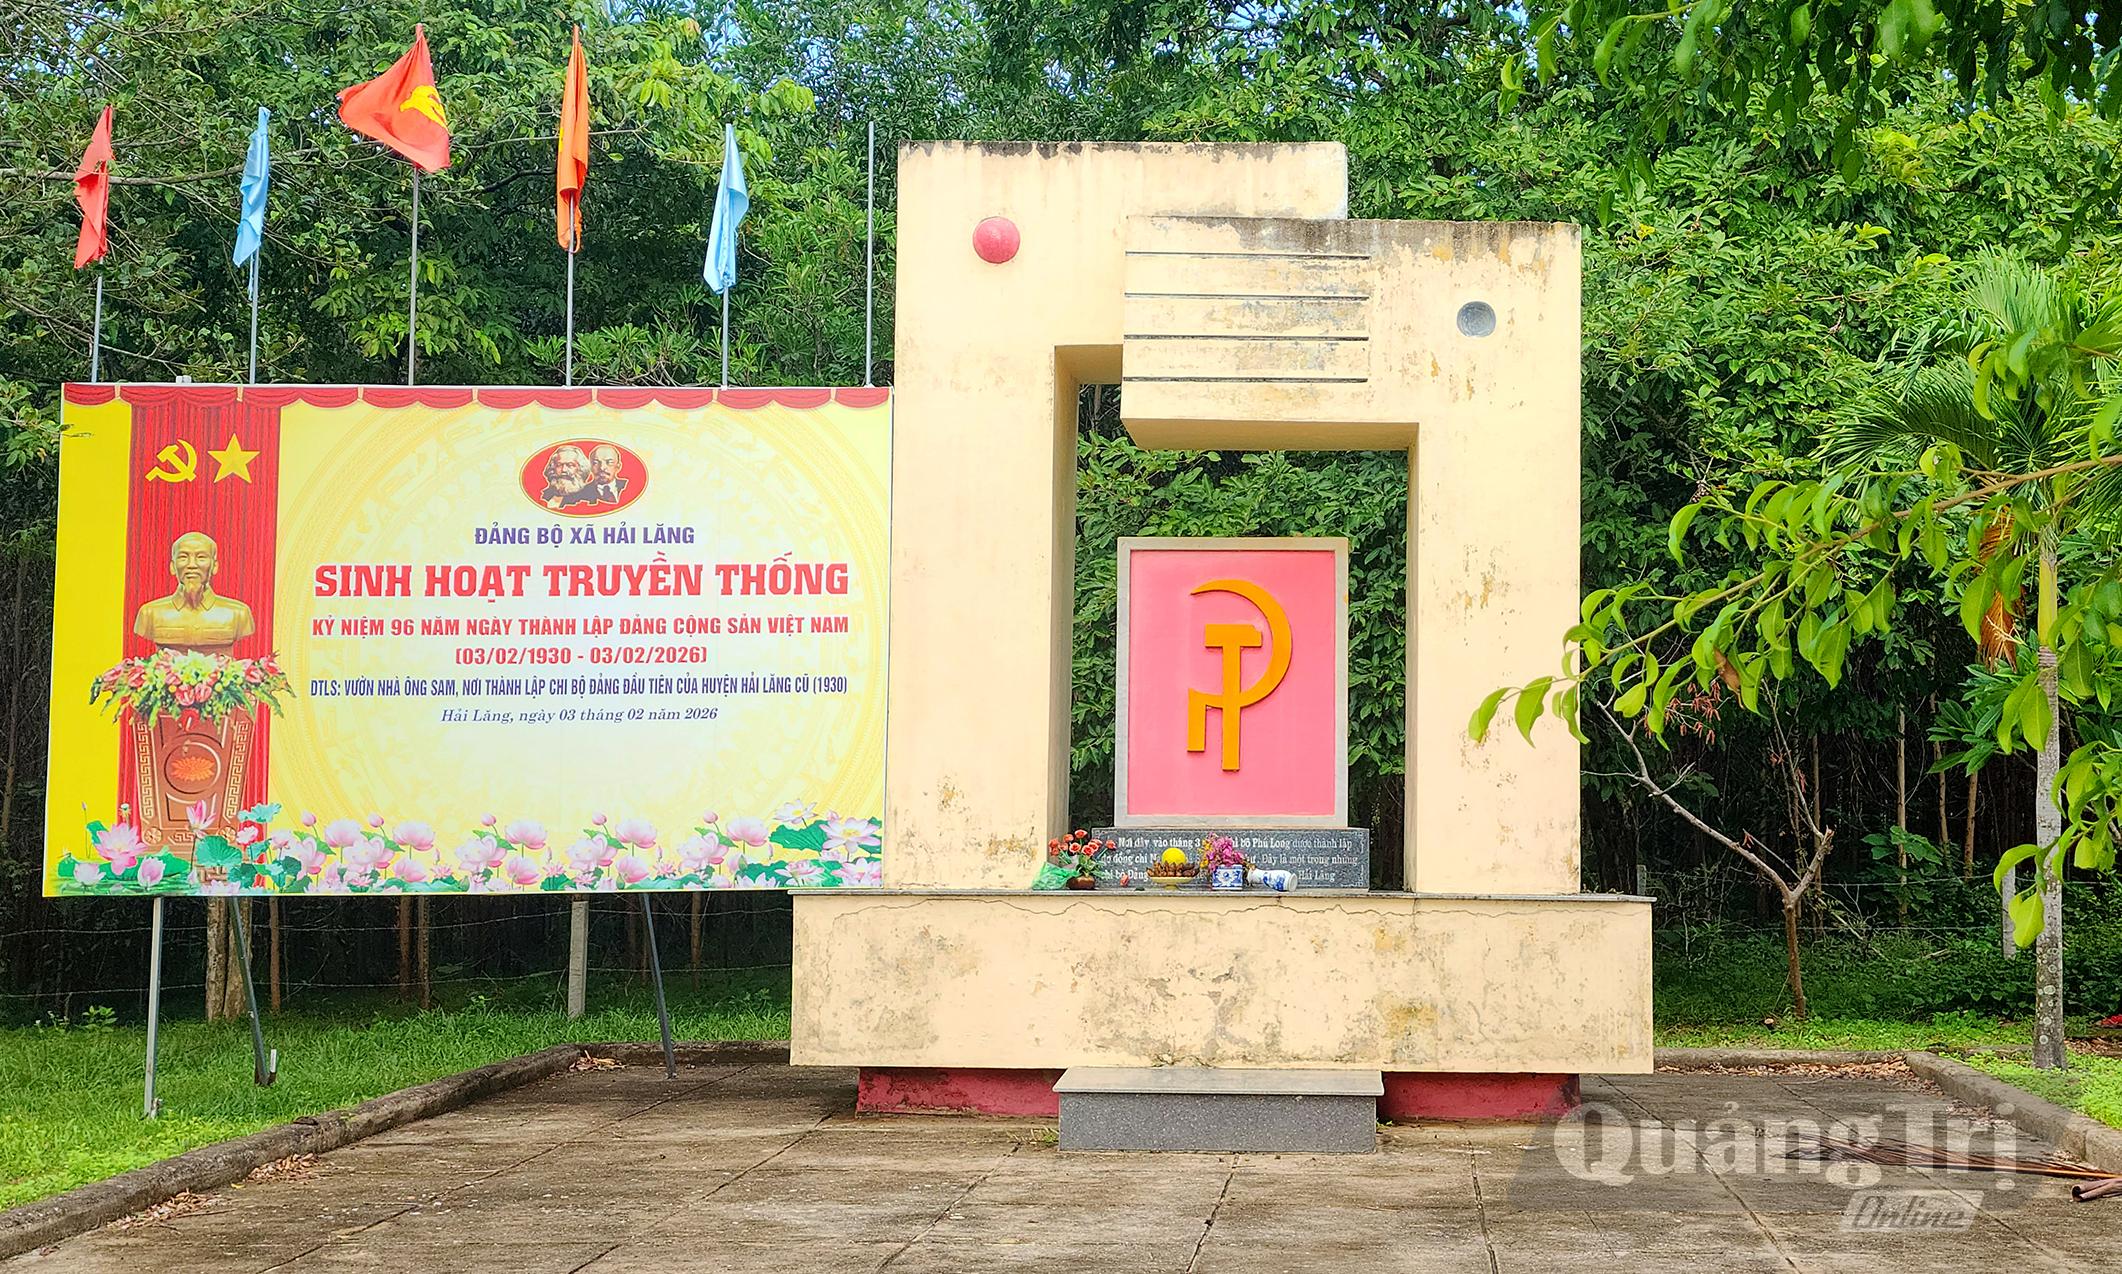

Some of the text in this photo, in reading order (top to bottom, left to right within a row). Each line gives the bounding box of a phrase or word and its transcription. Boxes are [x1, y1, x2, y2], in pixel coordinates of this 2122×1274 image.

[474, 521, 695, 548] ĐẢNG BỘ XÃ HẢI LĂNG
[314, 551, 848, 603] SINH HOẠT TRUYỀN THỐNG
[312, 613, 849, 639] KỶ NIỆM 96 NĂM NGÀY THÀNH LẬP ĐẢNG CỘNG SẢN VIỆT NAM
[455, 647, 571, 665] (03/02/1930
[590, 646, 707, 664] 03/02/2026)
[311, 671, 847, 699] DTLS: VƯỜN NHÀ ÔNG SAM, NƠI THÀNH LẬP CHI BỘ ĐẢNG ĐẦU TIÊN CỦA HUYỆN HẢI LĂNG CŨ (1930)
[442, 707, 719, 724] Hải Lăng, ngày 03 tháng 02 năm 2026
[1153, 837, 1168, 848] vào
[1169, 837, 1193, 849] tháng
[1252, 836, 1269, 848] Phú
[1270, 837, 1291, 850] Long
[1313, 838, 1337, 848] thành
[1279, 853, 1287, 863] là
